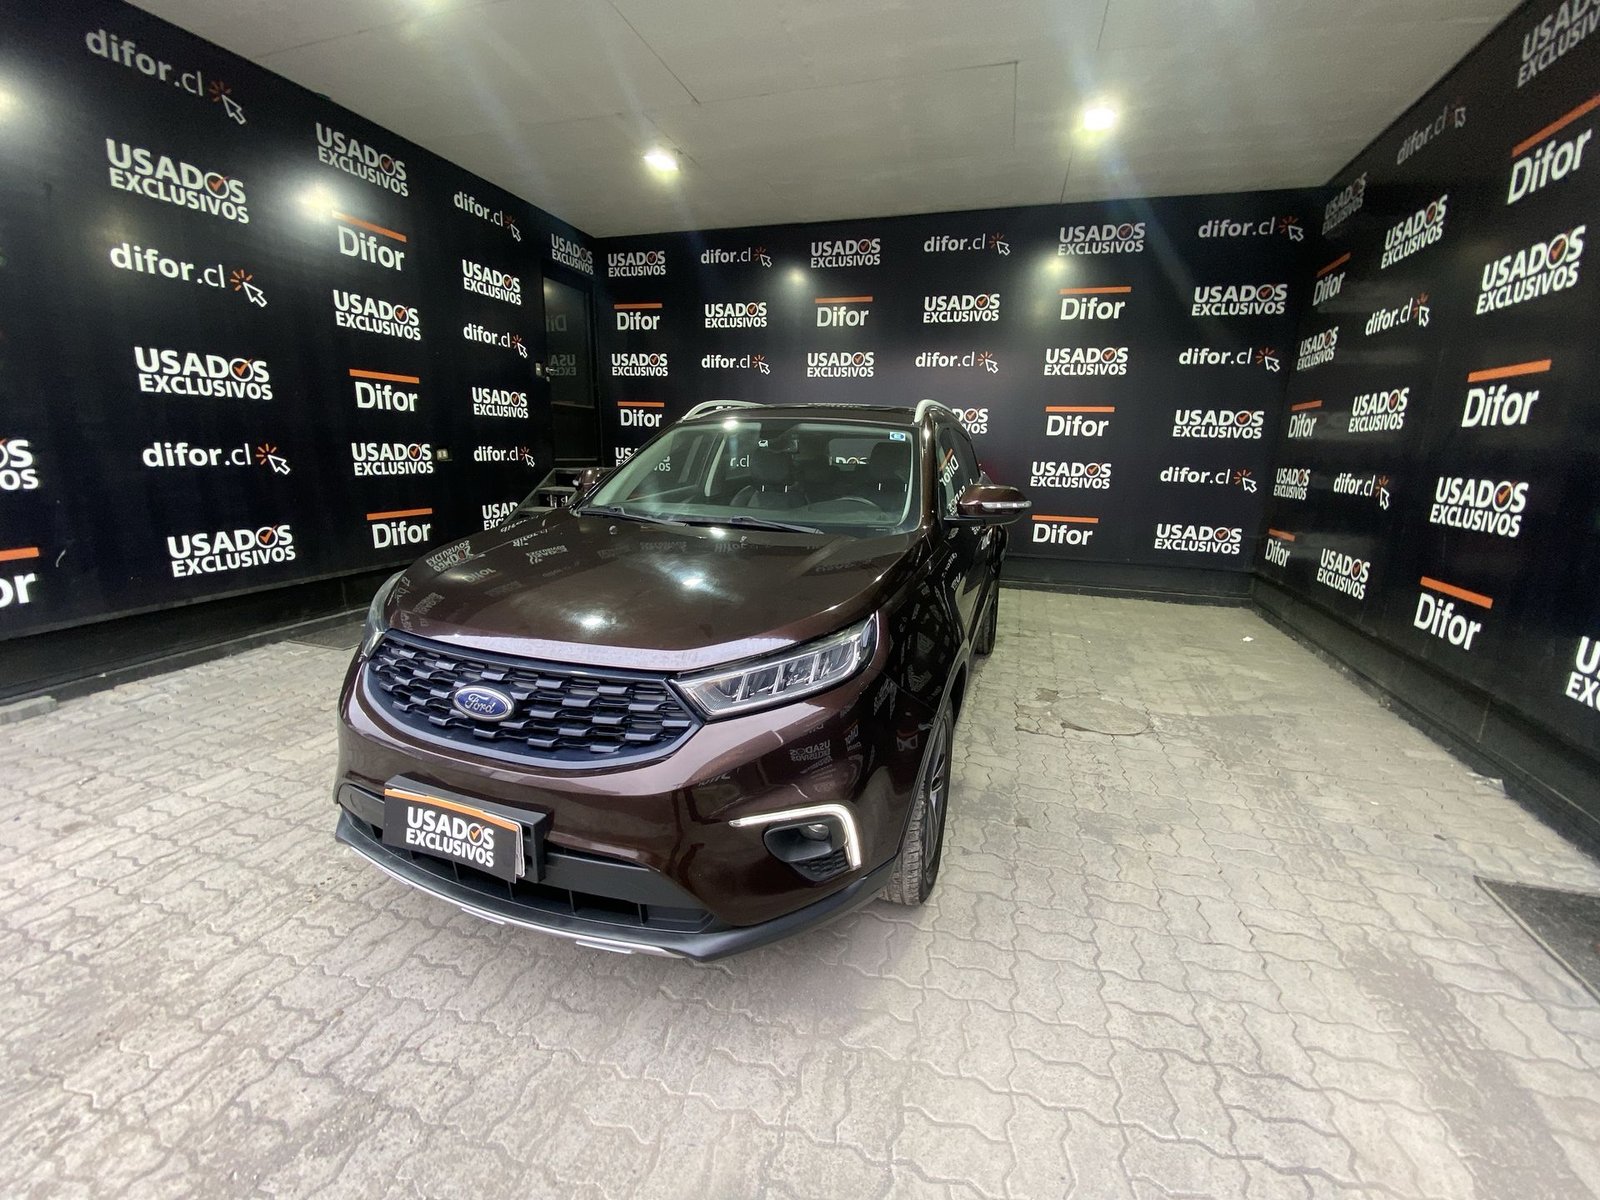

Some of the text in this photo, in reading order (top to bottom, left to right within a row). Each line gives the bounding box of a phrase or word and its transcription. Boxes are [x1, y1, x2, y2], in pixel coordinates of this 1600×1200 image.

[1521, 0, 1600, 62] USAD
[1517, 6, 1600, 89] EXCLUSIV
[86, 29, 204, 96] difor.cl
[1397, 106, 1448, 165] difor.cl
[316, 122, 408, 181] USADOS
[106, 138, 246, 204] USADOS
[318, 146, 409, 198] EXCLUSIVOS
[1507, 128, 1592, 205] Difor
[109, 167, 249, 224] EXCLUSIVOS
[453, 191, 503, 227] difor.cl
[1059, 222, 1146, 243] USADOS
[1198, 216, 1276, 238] difor.cl
[1385, 194, 1448, 251] USADOS
[337, 225, 405, 271] Difor
[551, 233, 593, 265] USADOS
[811, 238, 881, 257] USADOS
[923, 233, 986, 253] difor.cl
[1058, 240, 1144, 256] EXCLUSIVOS
[1381, 220, 1443, 269] EXCLUSIVOS
[110, 243, 225, 288] difor.cl
[552, 248, 594, 275] EXCLUSIVOS
[608, 251, 665, 267] USADOS
[700, 247, 751, 265] difor.cl
[810, 254, 880, 268] EXCLUSIVOS
[1481, 225, 1586, 291] USADOS
[462, 259, 520, 293] USADOS
[608, 265, 666, 277] EXCLUSIVOS
[463, 277, 522, 305] EXCLUSIVOS
[1193, 284, 1288, 303] USADOS
[1312, 271, 1345, 306] Difor
[1476, 261, 1579, 315] EXCLUSIVOS
[333, 289, 419, 326] USADOS
[704, 301, 767, 318] USADOS
[924, 293, 1000, 312] USADOS
[1060, 297, 1125, 321] Difor
[1191, 302, 1285, 316] EXCLUSIVOS
[335, 310, 421, 341] EXCLUSIVOS
[616, 311, 660, 331] Difor
[705, 316, 767, 328] EXCLUSIVOS
[816, 305, 869, 327] Difor
[922, 309, 999, 323] EXCLUSIVOS
[1364, 297, 1413, 336] difor.cl
[463, 323, 511, 348] difor.cl
[1300, 326, 1338, 356] USADOS
[134, 346, 270, 383] USADOS
[611, 353, 668, 368] USADOS
[701, 354, 750, 370] difor.cl
[807, 352, 874, 367] USADOS
[915, 351, 975, 368] difor.cl
[1046, 347, 1128, 364] USADOS
[1178, 348, 1252, 366] difor.cl
[1296, 346, 1335, 371] EXCLUSIVOS
[612, 365, 668, 377] EXCLUSIVOS
[807, 366, 874, 378] EXCLUSIVOS
[1043, 363, 1127, 376] EXCLUSIVOS
[139, 373, 273, 400] EXCLUSIVOS
[354, 381, 418, 412] Difor
[472, 387, 527, 408] USADOS
[473, 403, 529, 418] EXCLUSIVOS
[1352, 387, 1409, 416] USADOS
[1461, 384, 1539, 428] Difor
[620, 409, 662, 427] Difor
[1046, 415, 1109, 437] Difor
[1174, 409, 1264, 426] USADOS
[1288, 411, 1317, 439] Difor
[1348, 411, 1404, 433] EXCLUSIVOS
[1172, 425, 1262, 439] EXCLUSIVOS
[142, 442, 252, 467] difor.cl
[352, 442, 432, 462] USADOS
[474, 446, 518, 462] difor.cl
[354, 460, 434, 476] EXCLUSIVOS
[1032, 461, 1112, 478] USADOS
[1160, 466, 1231, 485] difor.cl
[1276, 467, 1311, 488] USADOS
[1030, 475, 1110, 490] EXCLUSIVOS
[1273, 485, 1307, 500] EXCLUSIVOS
[1333, 473, 1375, 497] difor.cl
[1435, 476, 1529, 513] USADOS
[482, 502, 518, 520] USAD
[1429, 504, 1522, 538] EXCLUSIVOS
[167, 524, 293, 560] USADOS
[371, 520, 431, 549] Difor
[1032, 523, 1093, 546] Difor
[1156, 523, 1242, 543] USADOS
[1154, 538, 1240, 555] EXCLUSIVOS
[1265, 538, 1290, 568] Difor
[171, 543, 296, 578] EXCLUSIVOS
[1320, 548, 1370, 583] USADOS
[1317, 567, 1366, 600] EXCLUSIVOS
[1413, 593, 1481, 650] Difor
[464, 694, 496, 714] Ford
[407, 807, 494, 850] USADOS
[405, 827, 494, 868] EXCLUSIVOS
